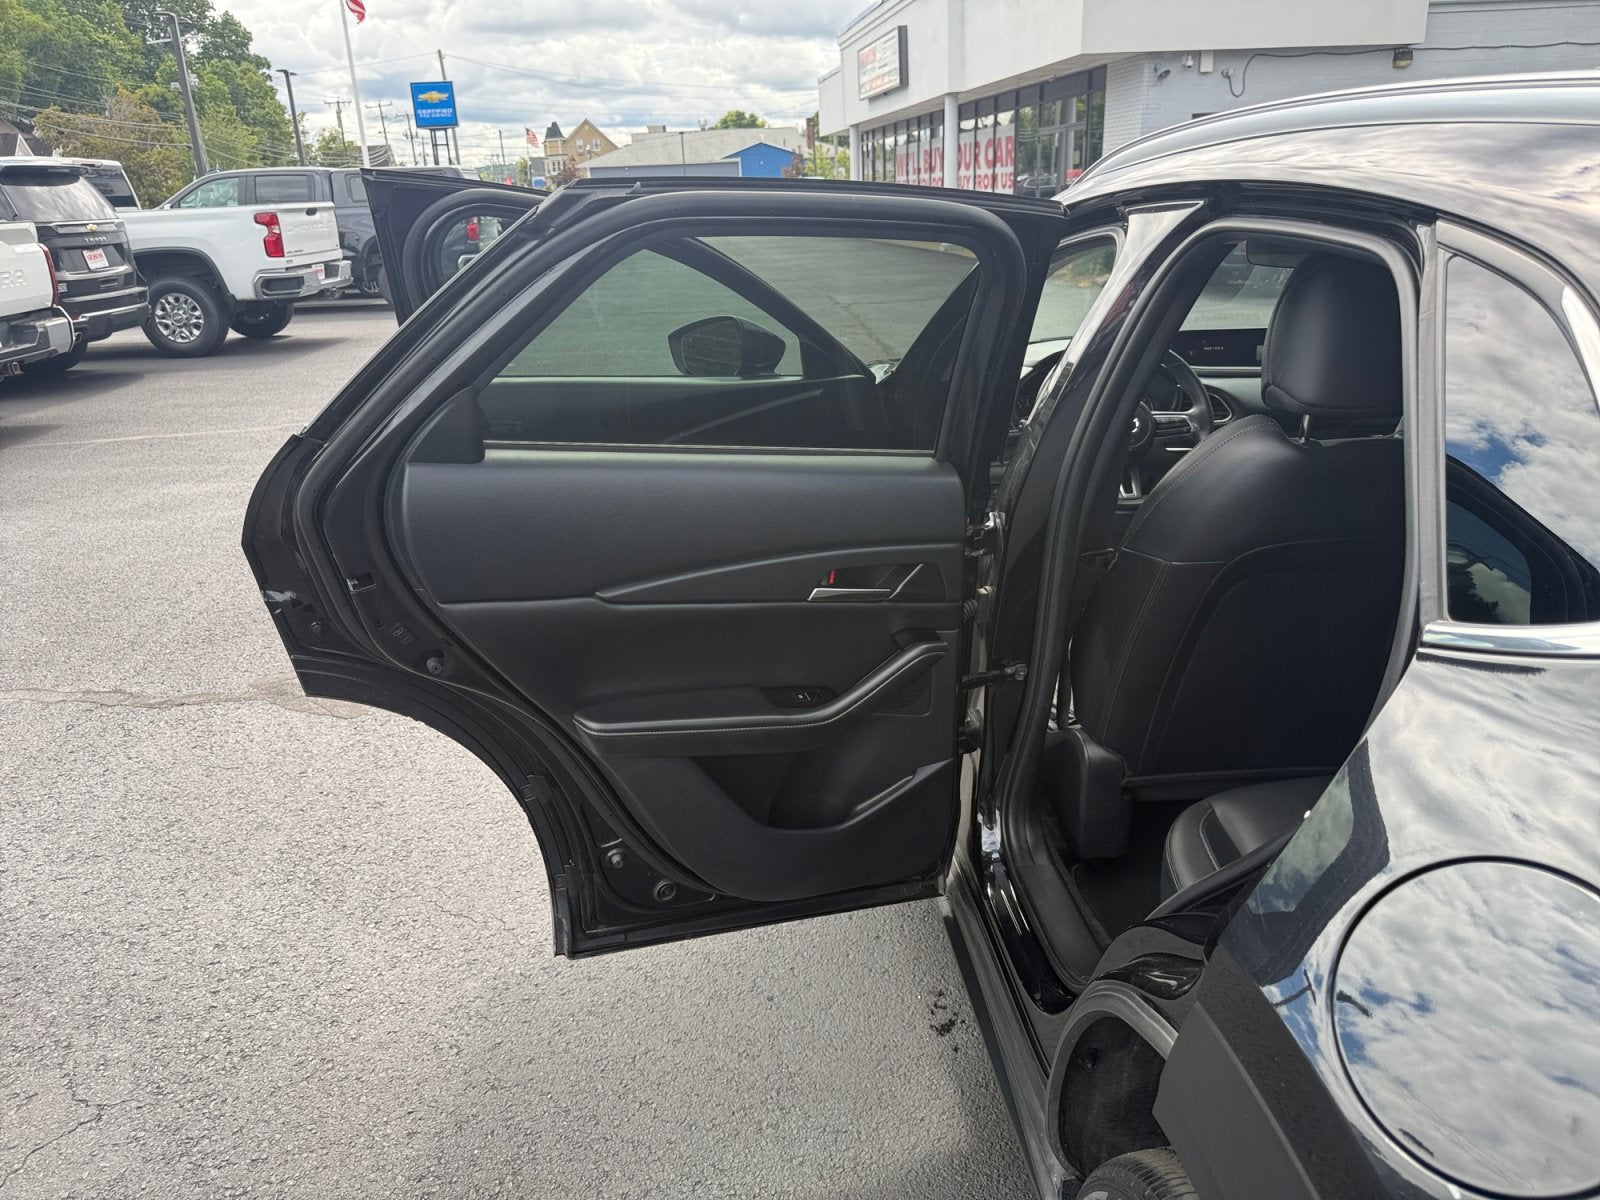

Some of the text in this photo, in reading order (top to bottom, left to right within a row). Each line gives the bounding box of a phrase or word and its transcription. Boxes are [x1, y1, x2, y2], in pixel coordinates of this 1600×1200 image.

[923, 147, 944, 174] BUY
[958, 141, 981, 171] OUR
[985, 136, 1014, 169] CAR
[1001, 171, 1014, 189] US
